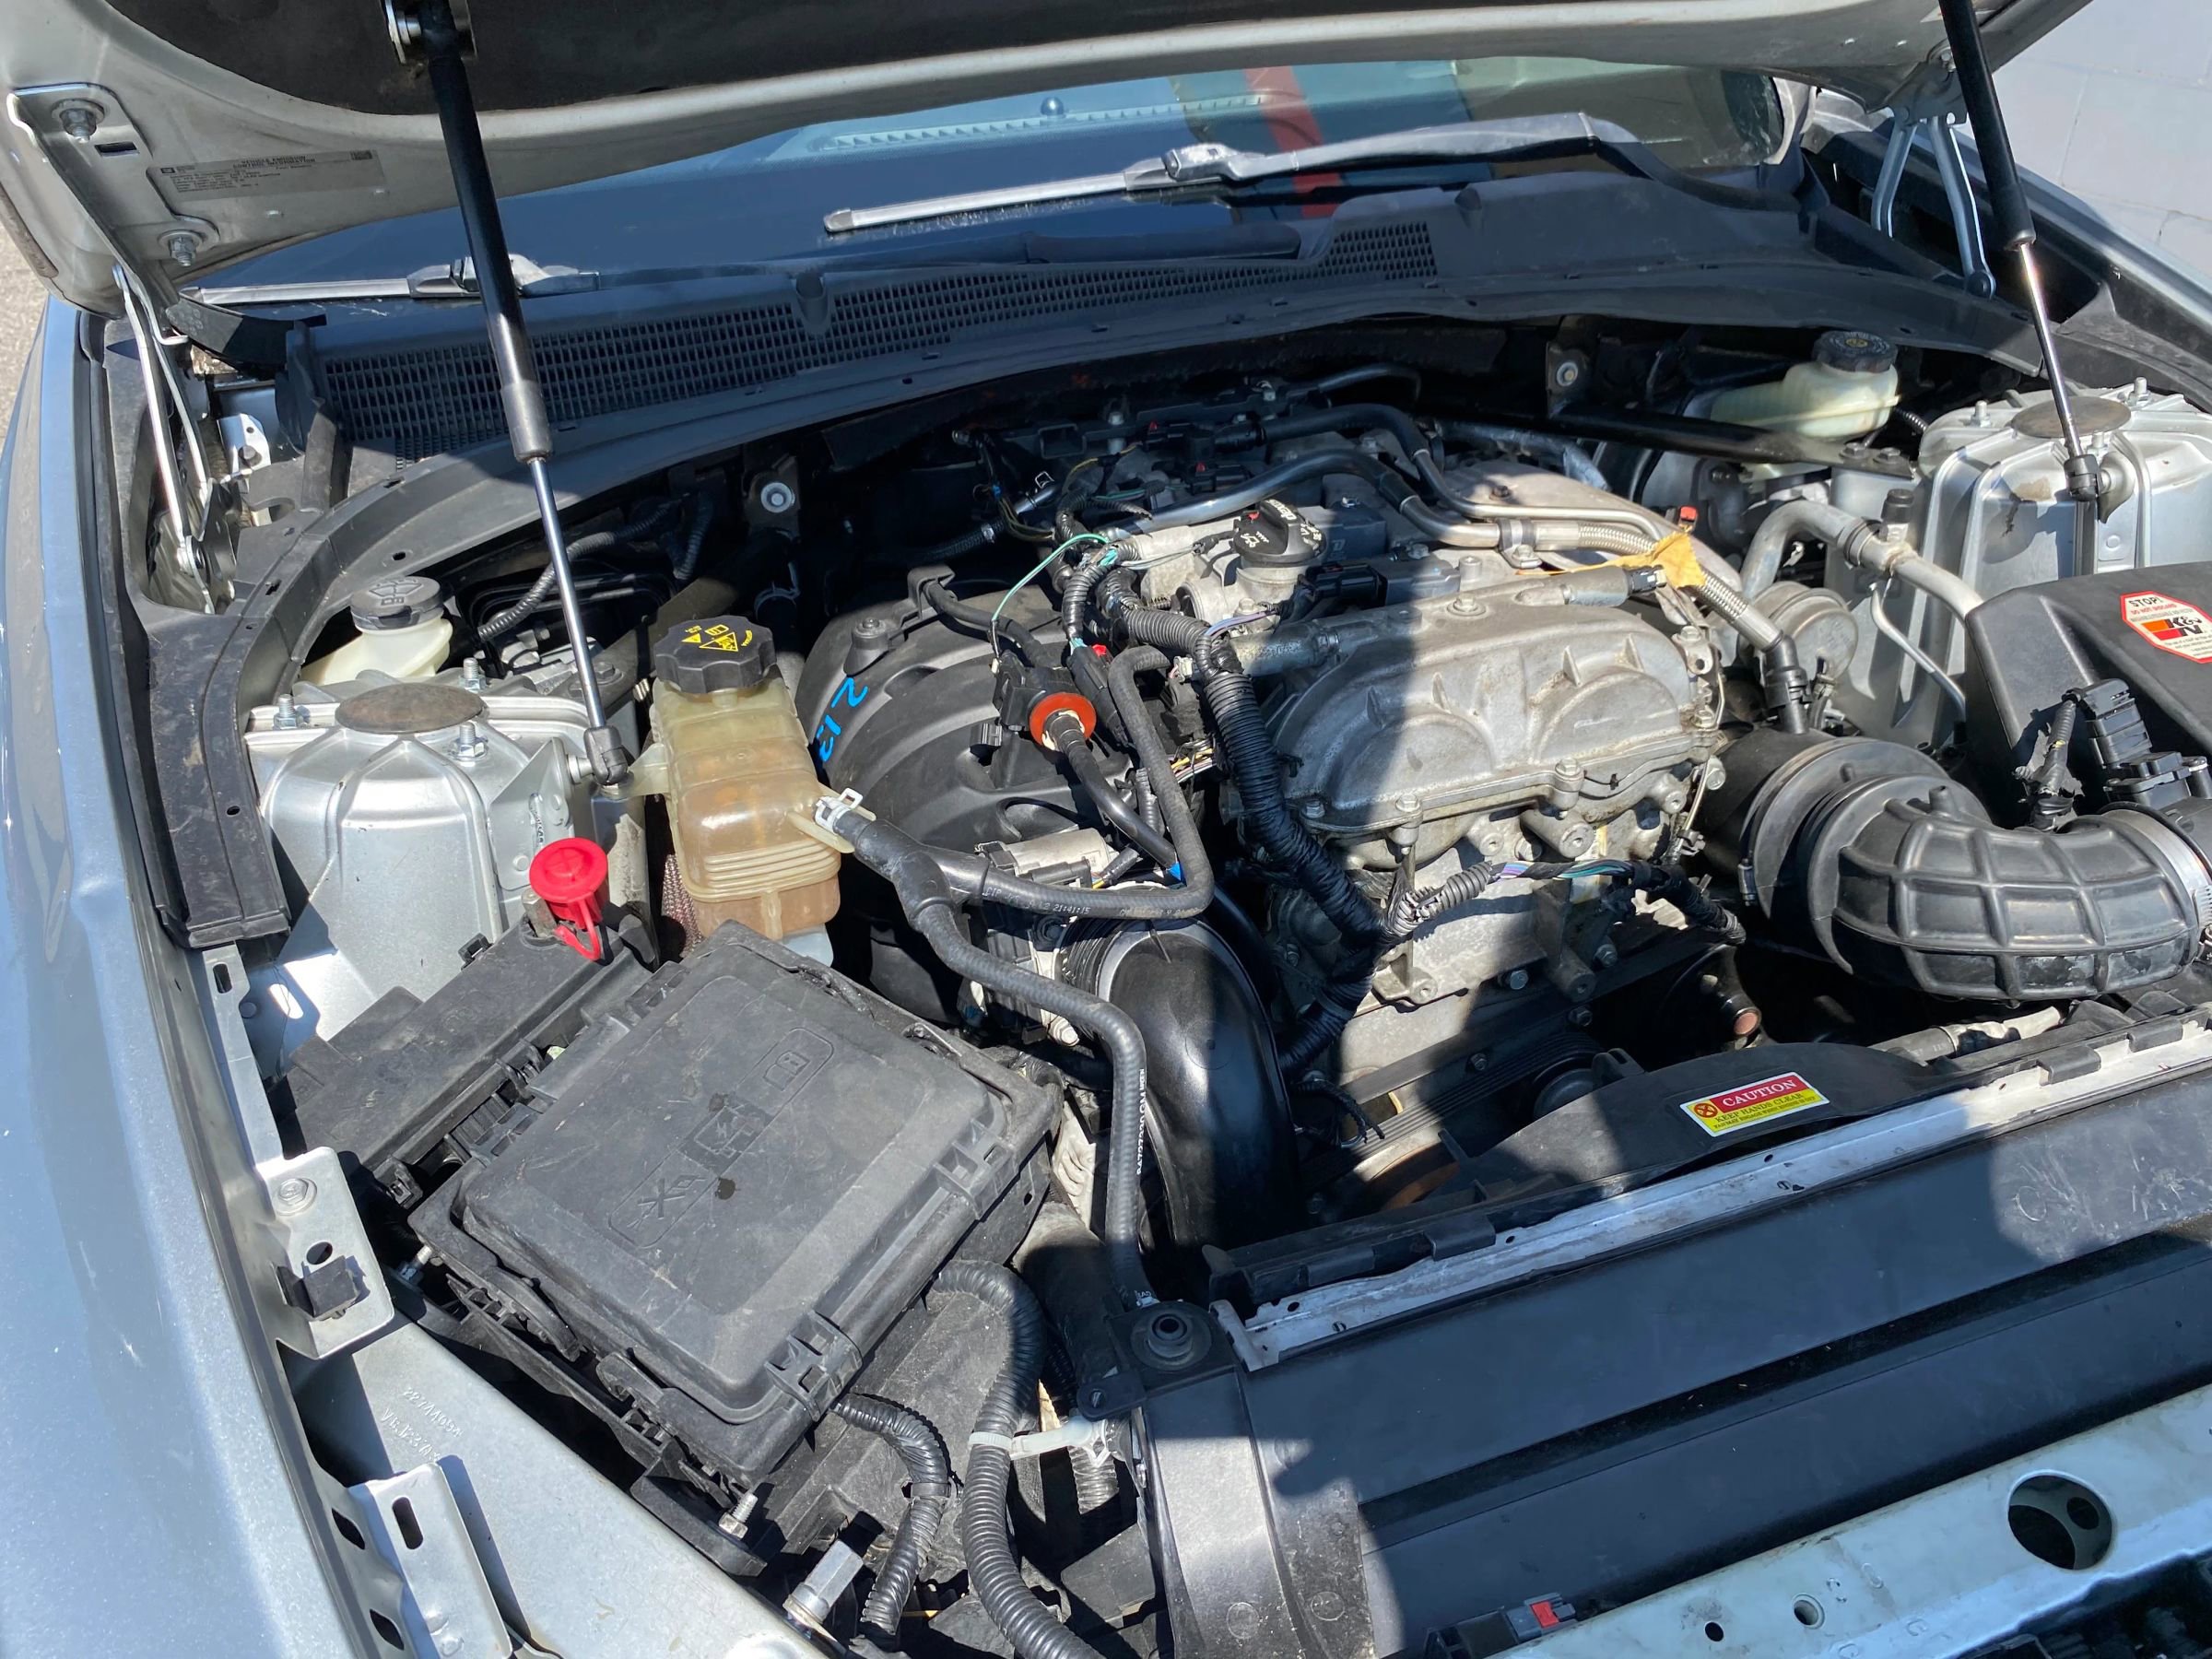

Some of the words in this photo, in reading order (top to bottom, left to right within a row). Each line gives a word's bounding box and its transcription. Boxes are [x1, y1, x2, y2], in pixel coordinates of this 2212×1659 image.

[2128, 596, 2163, 607] STOP!
[1722, 1079, 1797, 1107] CAUTION
[1715, 1112, 1740, 1123] KEEP
[1741, 1102, 1772, 1116] HANDS
[1773, 1092, 1803, 1106] CLEAR
